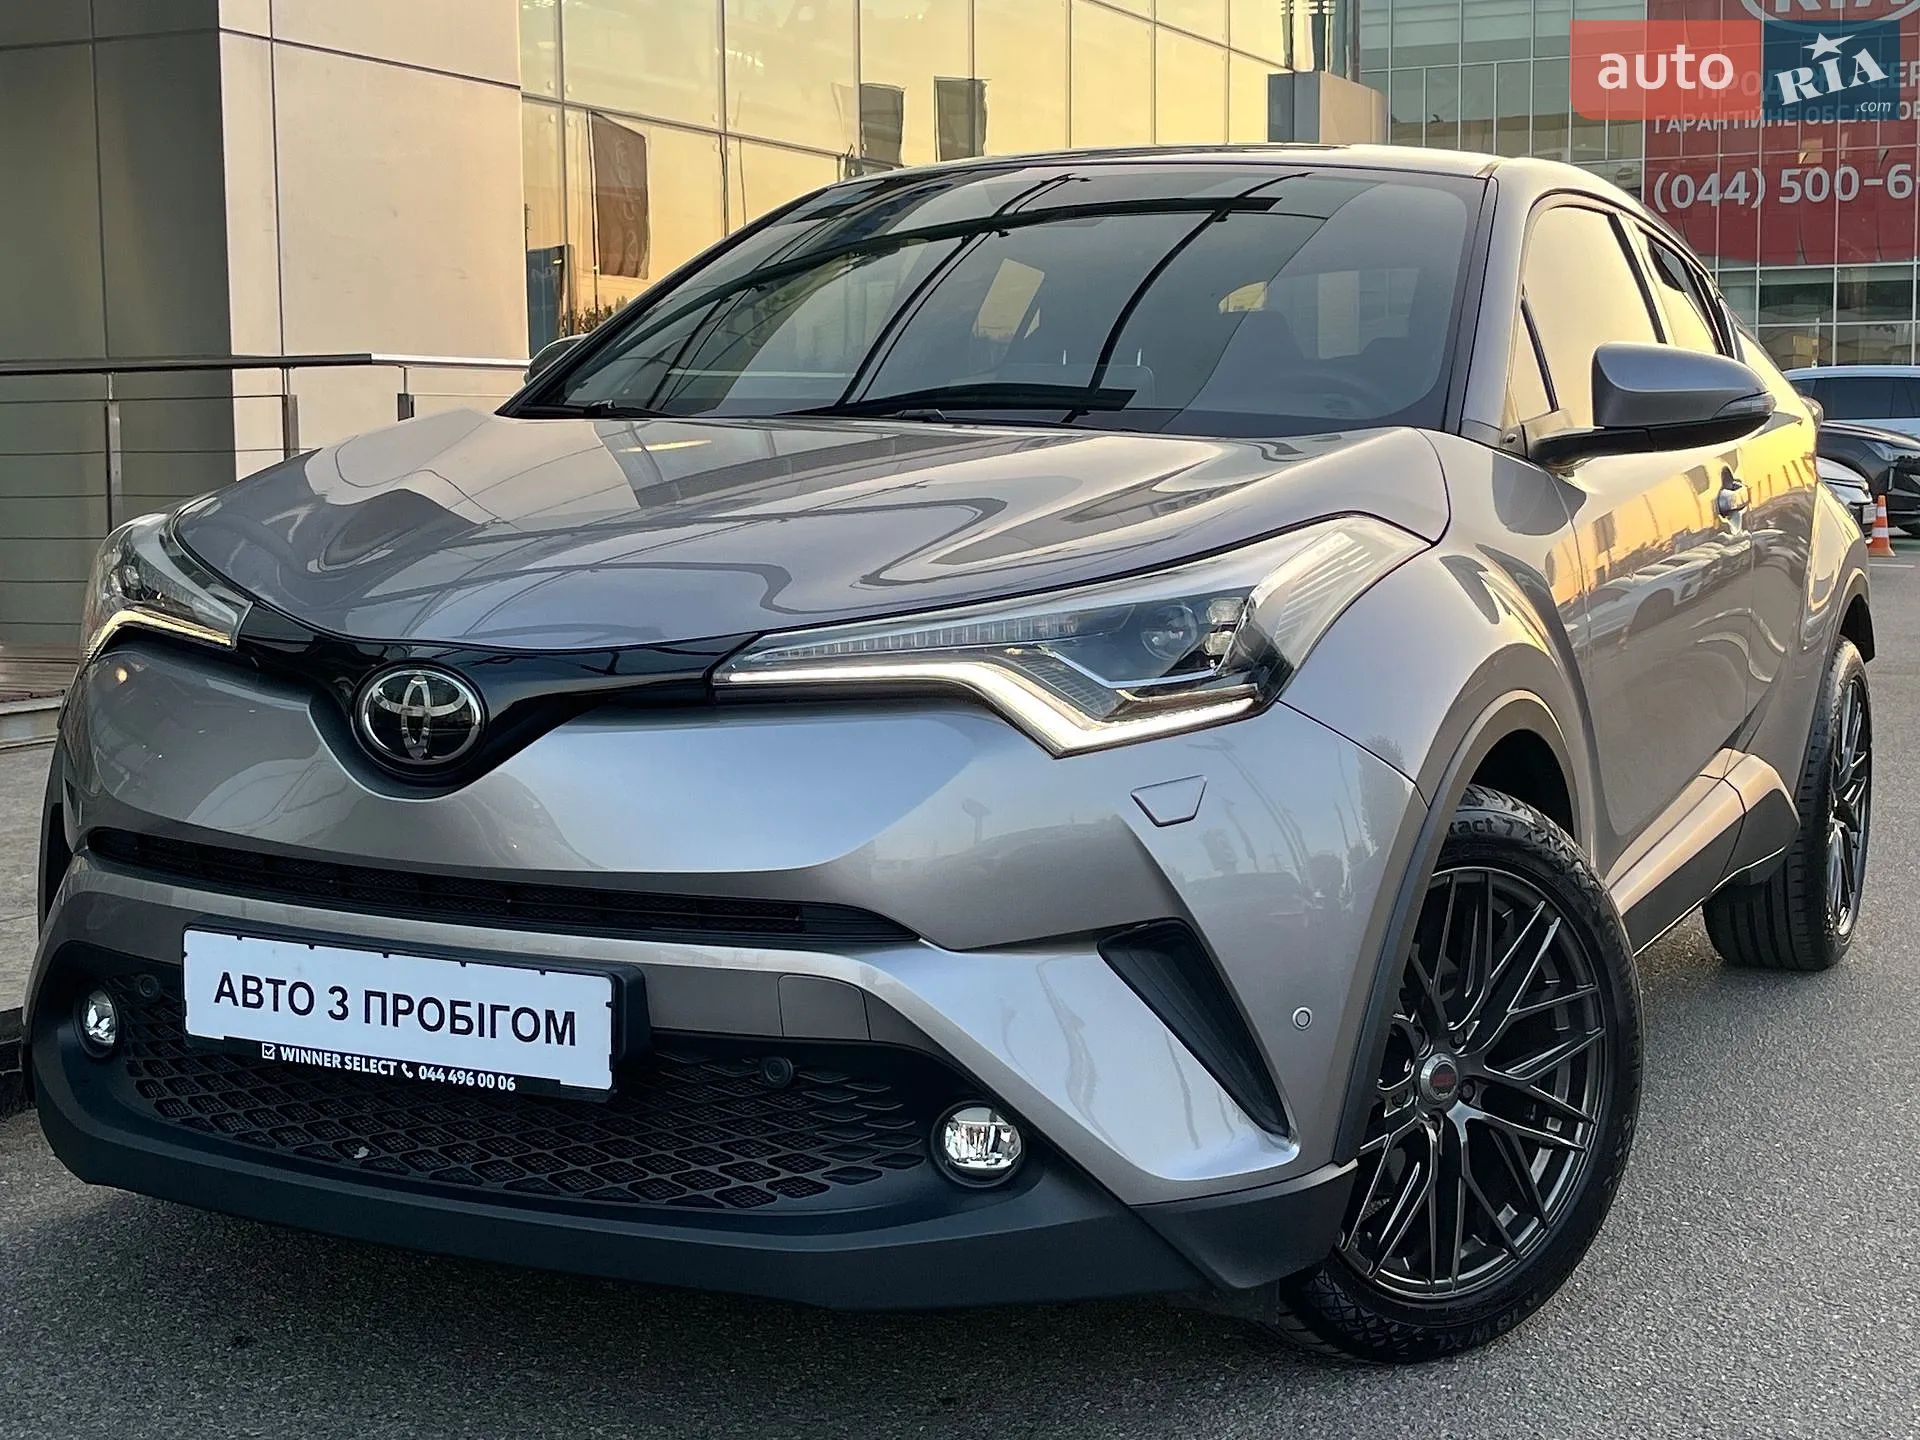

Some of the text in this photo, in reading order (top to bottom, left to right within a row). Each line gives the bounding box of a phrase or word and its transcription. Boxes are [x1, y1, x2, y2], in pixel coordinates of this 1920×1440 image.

[1653, 163, 1913, 213] (044) 500-6
[214, 971, 316, 1016] АВТО
[363, 990, 577, 1047] ПРОБІГОМ
[280, 1046, 516, 1091] WINNER SELECT 044 496 00 06
